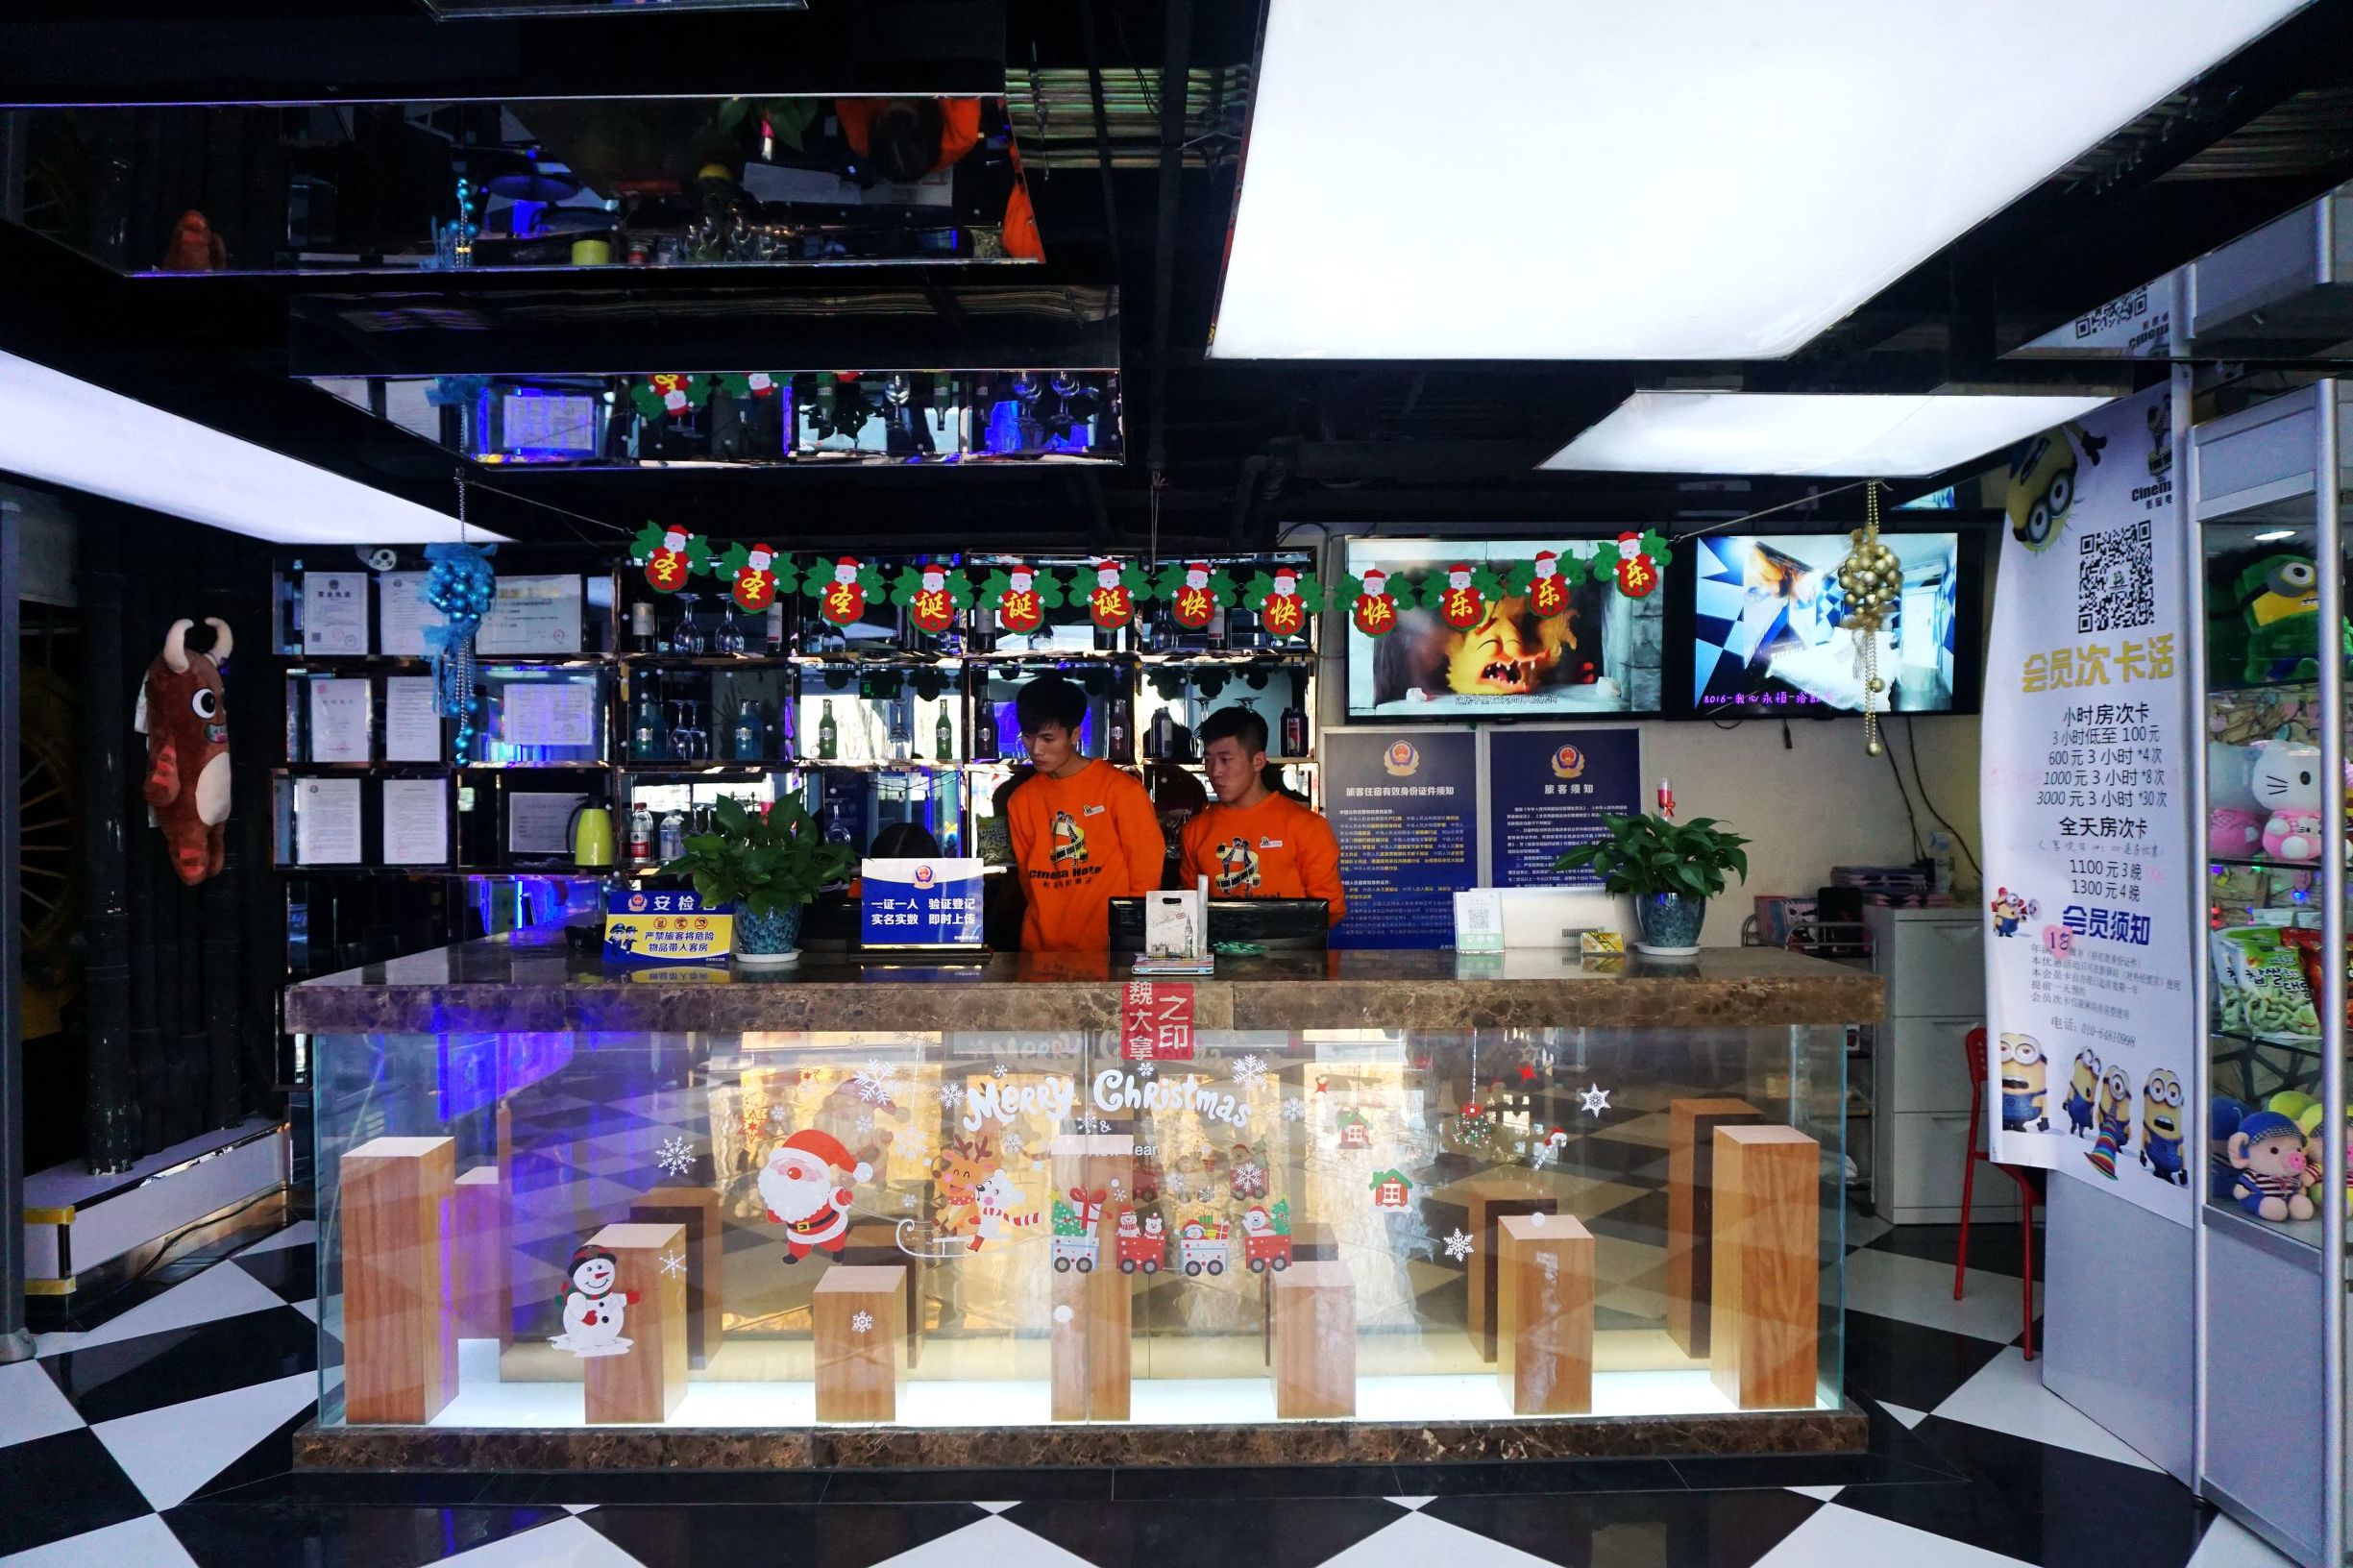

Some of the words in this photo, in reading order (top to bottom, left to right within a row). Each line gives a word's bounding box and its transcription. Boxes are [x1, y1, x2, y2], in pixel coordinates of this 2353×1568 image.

[654, 552, 677, 581] 圣
[741, 571, 766, 600] 圣
[829, 585, 854, 613] 圣
[916, 592, 947, 619] 诞
[1005, 593, 1037, 620] 诞
[1093, 590, 1126, 616] 诞
[1182, 590, 1208, 619] 快
[1270, 598, 1296, 626] 快
[1363, 597, 1391, 625] 快
[1451, 590, 1473, 618] 乐
[1538, 579, 1561, 606] 乐
[1627, 558, 1650, 586] 乐
[2022, 632, 2174, 693] 会员次卡活
[2063, 701, 2150, 727] 小时房次卡
[1346, 786, 1455, 796] 旅客住宿有效身份证件须知
[1544, 784, 1594, 795] 旅客须知
[2059, 817, 2147, 840] 全天房次卡
[2070, 859, 2142, 881] 1100元3晚
[2071, 879, 2141, 902] 1300元4晚
[653, 895, 717, 911] 安检
[871, 898, 919, 910] 一证一人
[928, 898, 976, 910] 验证登记
[871, 914, 919, 925] 实名实数
[928, 914, 976, 925] 即时上传
[2063, 905, 2151, 946] 会员须知
[645, 931, 715, 941] 严禁旅客将危险
[2049, 932, 2071, 950] 18
[649, 943, 708, 952] 物品带入客房
[1129, 981, 1153, 1060] 魏大拿
[1158, 994, 1189, 1051] 之印
[963, 1076, 1075, 1132] Merry
[1093, 1068, 1253, 1128] Christmas
[1128, 1144, 1159, 1157] ear
